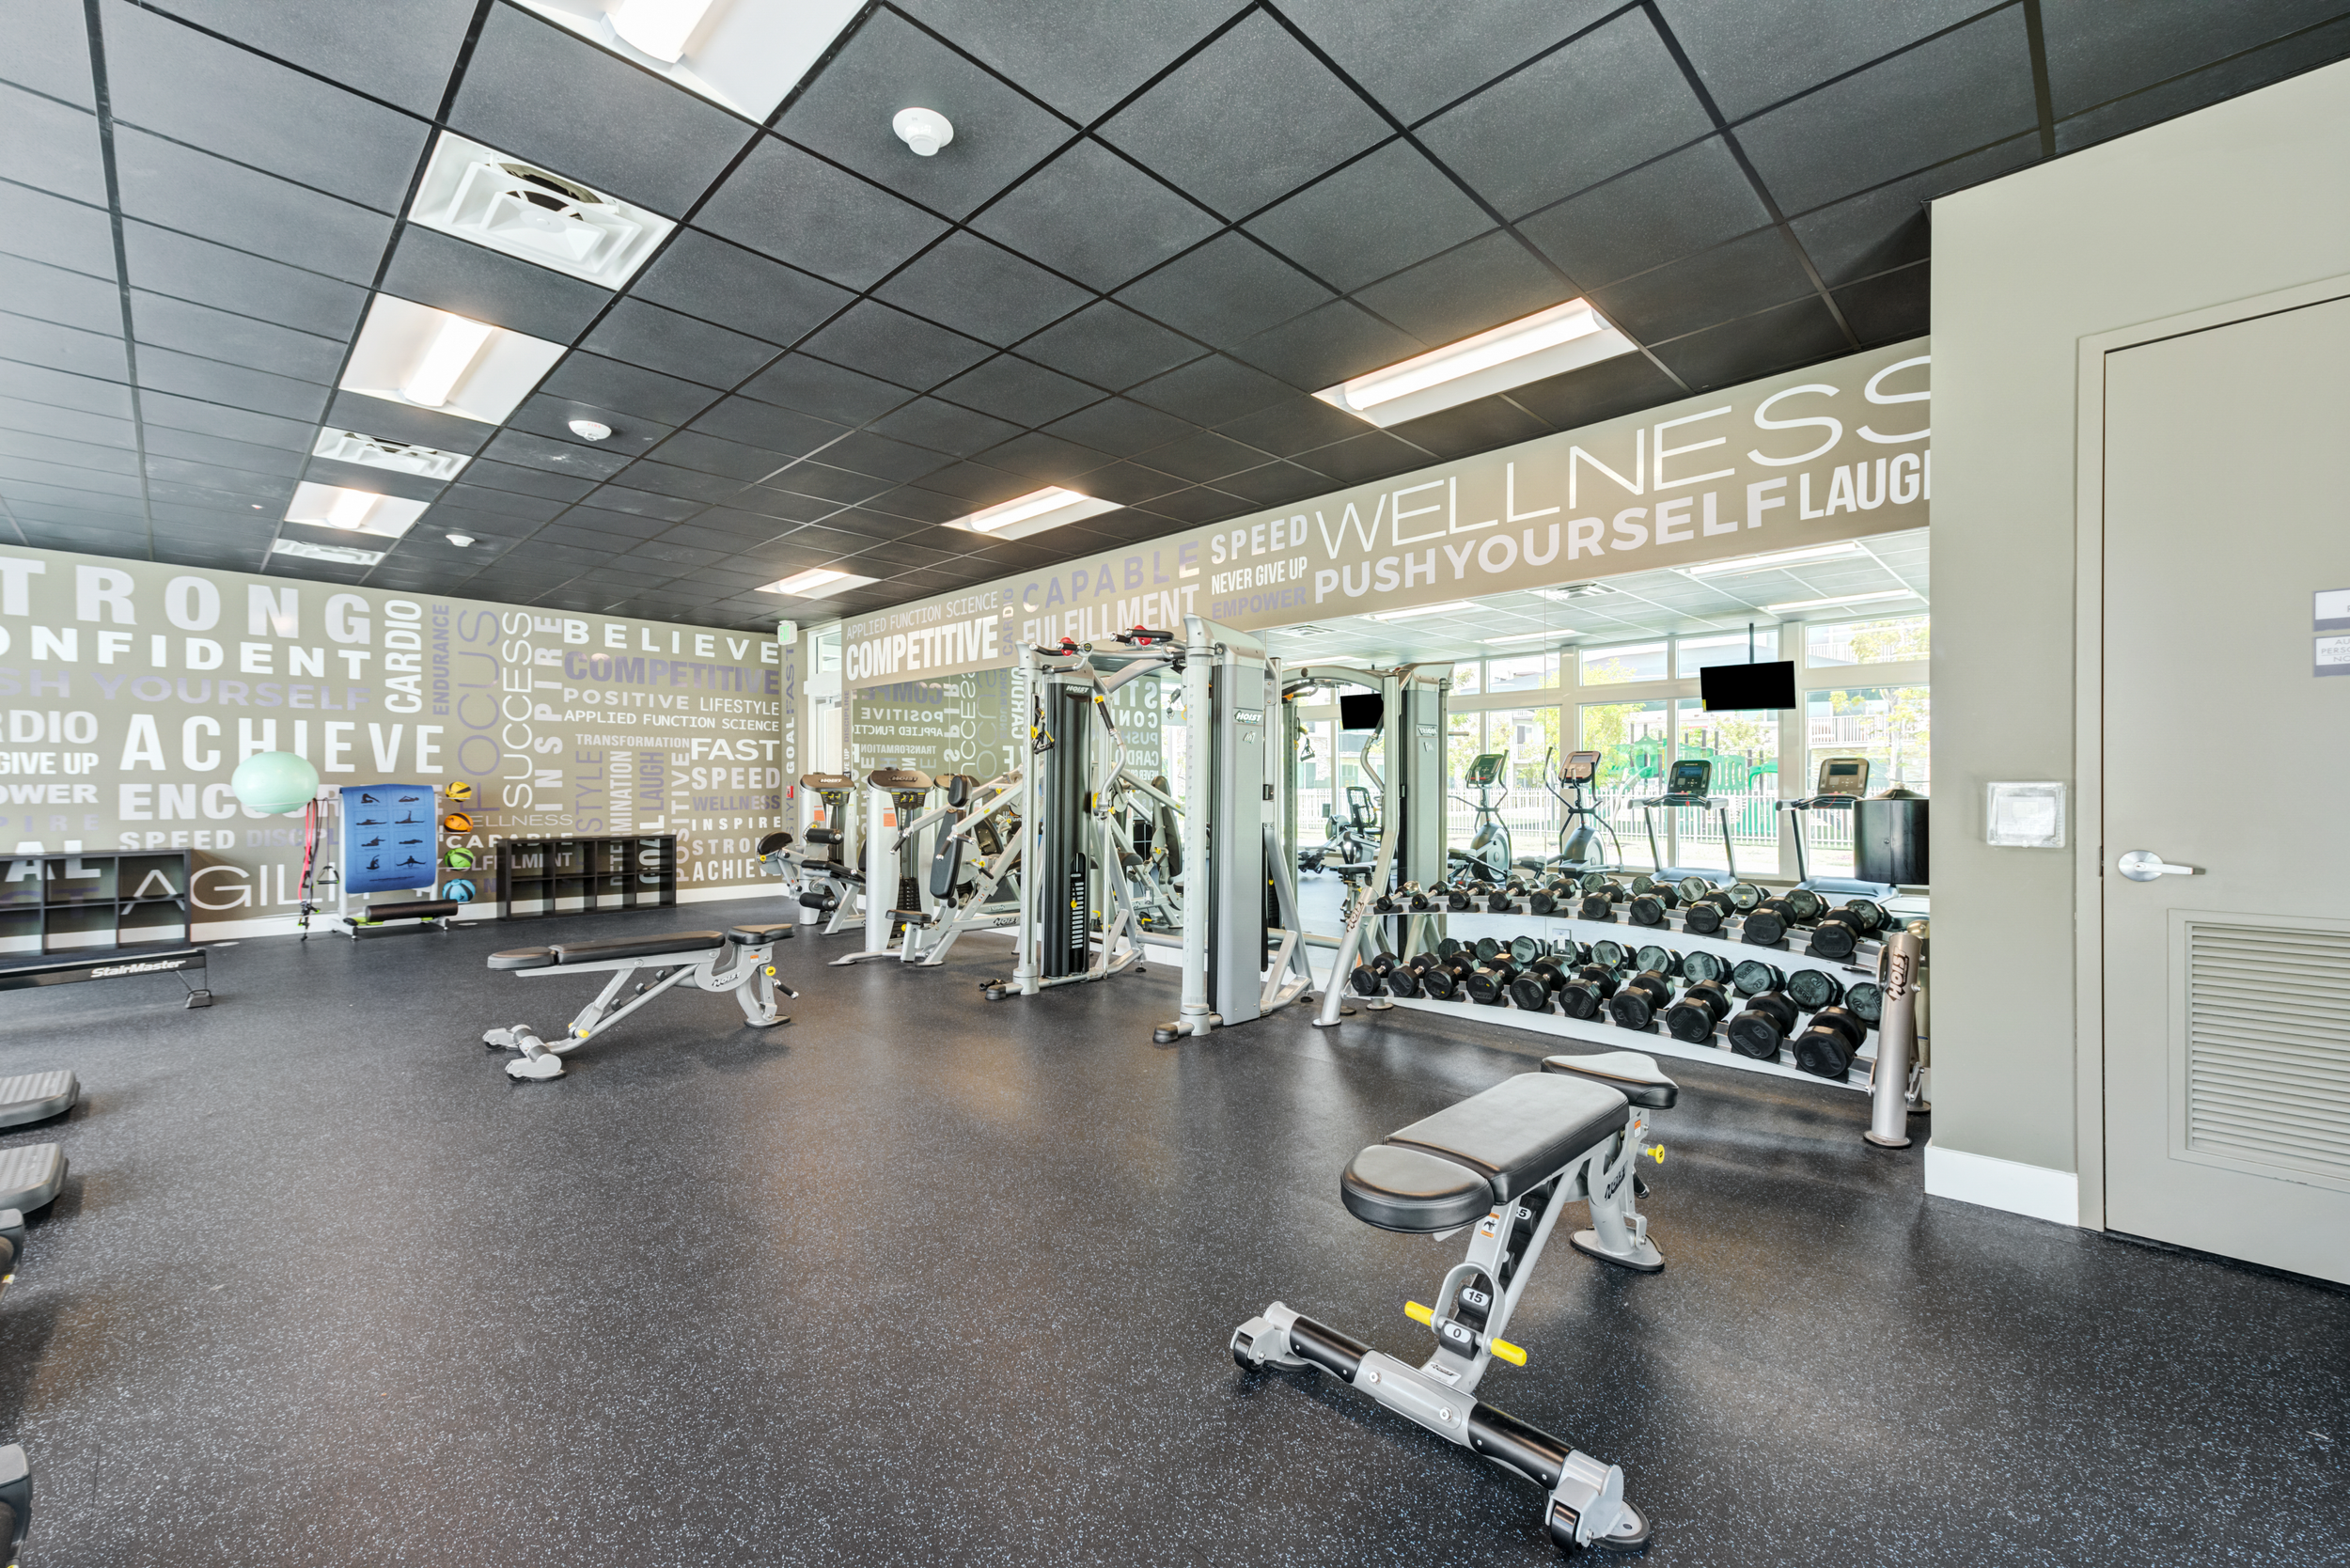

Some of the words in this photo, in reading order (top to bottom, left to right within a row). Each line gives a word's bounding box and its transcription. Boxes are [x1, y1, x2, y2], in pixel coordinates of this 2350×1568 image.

[1315, 355, 1930, 560] WELLNESS
[1799, 449, 1930, 521] LAUG
[1211, 514, 1308, 564] SPEED
[1023, 541, 1200, 613] CAPABLE
[1212, 568, 1252, 595] NEVER
[1255, 560, 1286, 587] GIVE
[1289, 556, 1308, 580] UP
[846, 617, 886, 641] APPLIED
[890, 604, 941, 632] FUNCTION
[946, 590, 998, 619] SCIENCE
[1002, 588, 1014, 656] CARDIO
[1212, 586, 1307, 619] EMPOWER
[384, 600, 422, 714] CARDIO
[432, 604, 449, 715] ENDURANCE
[564, 619, 779, 665] BELIEVE
[846, 614, 998, 682] COMPETITIVE
[90, 672, 371, 711] YOURSELF
[564, 651, 780, 695] COMPETITIVE
[458, 610, 500, 815] FOCUS
[502, 612, 533, 809] SUCCESS
[534, 616, 563, 812] INSPIRE
[564, 687, 690, 710] POSITIVE
[699, 697, 779, 716] LIFESTYLE
[564, 710, 636, 725] APPLIED
[643, 713, 715, 729] FUNCTION
[721, 718, 779, 732] SCIENCE
[1235, 712, 1261, 722] HOIST
[0, 709, 99, 745] DIO
[119, 713, 445, 775] ACHIEVE
[575, 733, 690, 748] TRANSFORMATION
[786, 716, 794, 775] GOAL
[63, 752, 100, 775] UP
[691, 738, 780, 761] FAST
[575, 750, 603, 833] STYLE
[639, 752, 664, 811] LAUGH
[692, 767, 780, 791] SPEED
[470, 814, 573, 827] ELLNESS
[671, 752, 690, 882] POSITIVE
[692, 794, 780, 812] WELLNESS
[692, 816, 781, 832] INSPIRE
[119, 830, 235, 851] SPEED
[91, 960, 186, 979] StairMaster
[712, 971, 741, 987] HOIST
[1888, 946, 1906, 1001] HOIST
[1468, 1290, 1484, 1305] 15
[1452, 1328, 1463, 1340] 0
